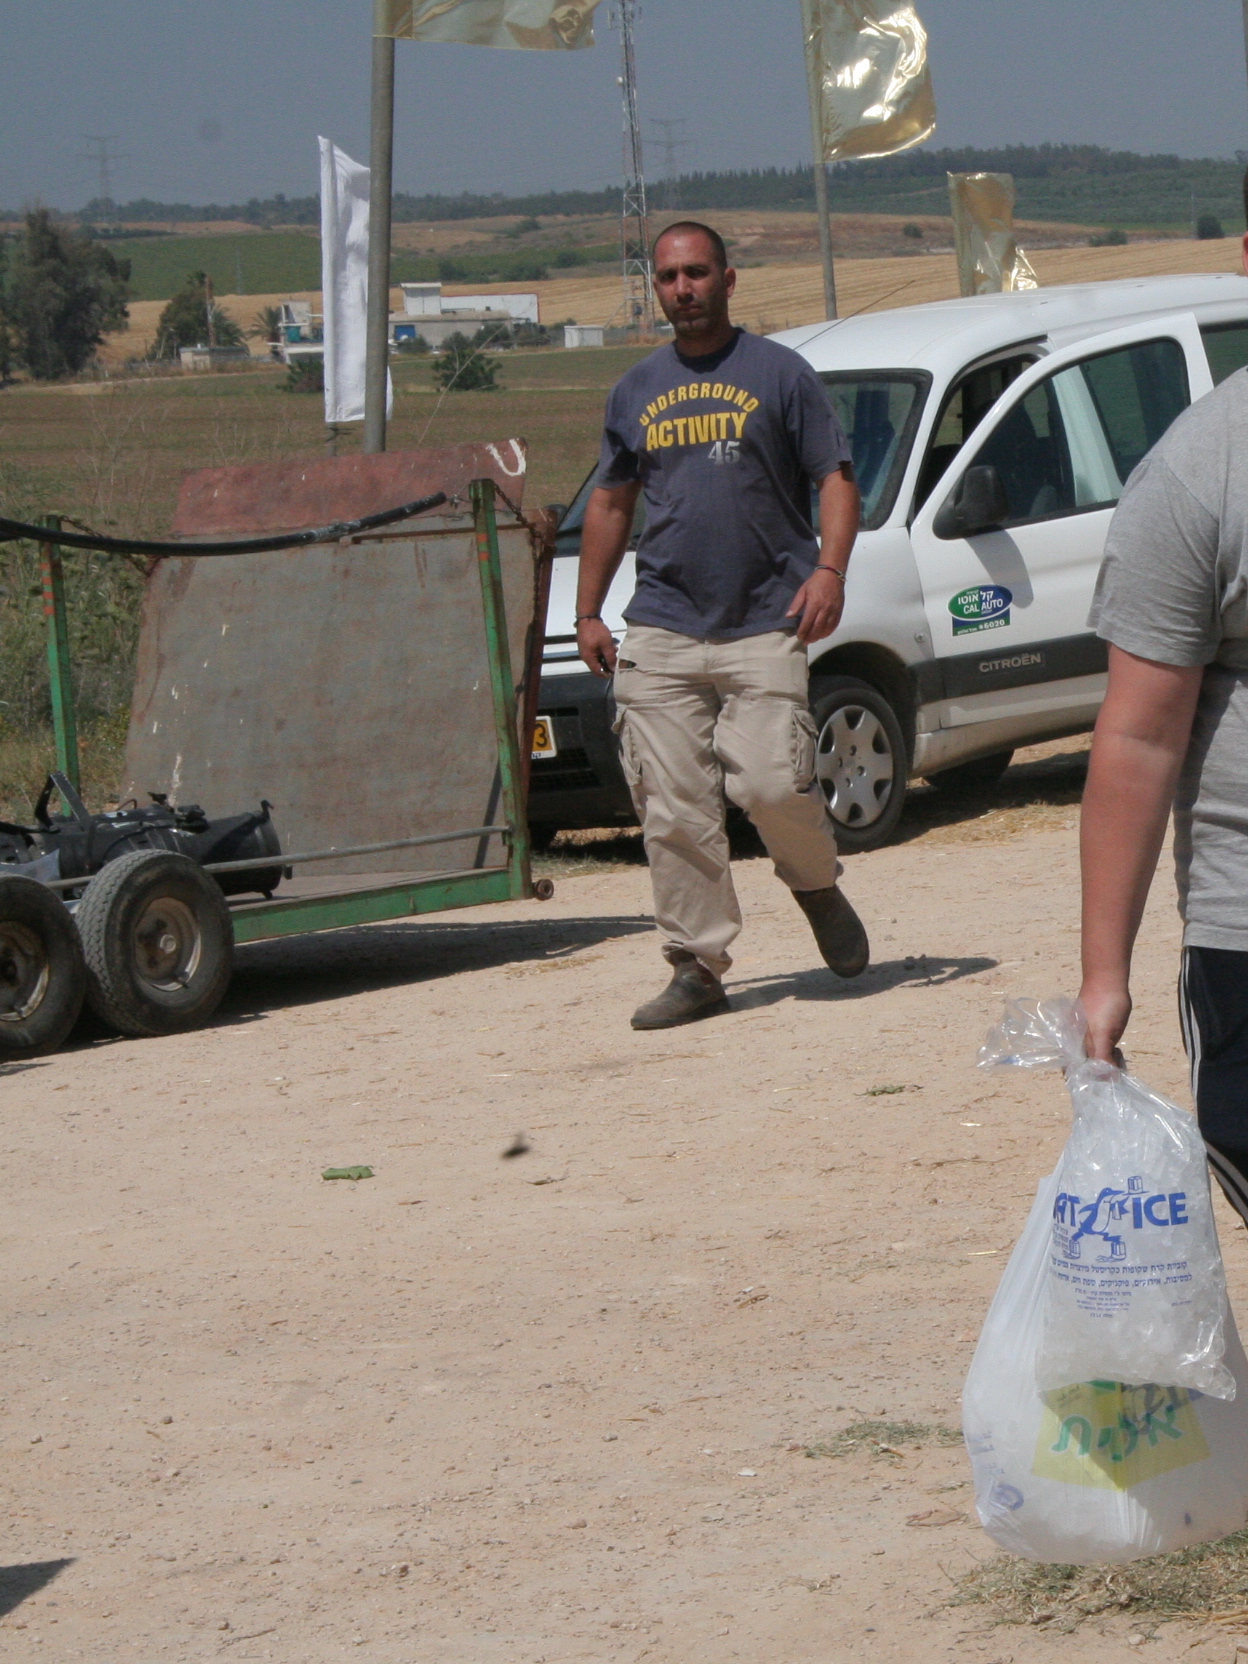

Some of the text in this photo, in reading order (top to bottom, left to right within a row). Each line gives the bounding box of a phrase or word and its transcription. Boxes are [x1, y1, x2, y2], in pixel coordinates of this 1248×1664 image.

[639, 382, 760, 426] UNDERGROUND
[646, 411, 748, 451] ACTIVITY
[708, 440, 741, 465] 45
[957, 593, 979, 605] אוטו
[963, 604, 980, 615] CAL
[981, 598, 1004, 611] AUTO
[980, 590, 994, 601] קל
[979, 652, 1042, 673] CITROËN
[1132, 1192, 1189, 1230] ICE
